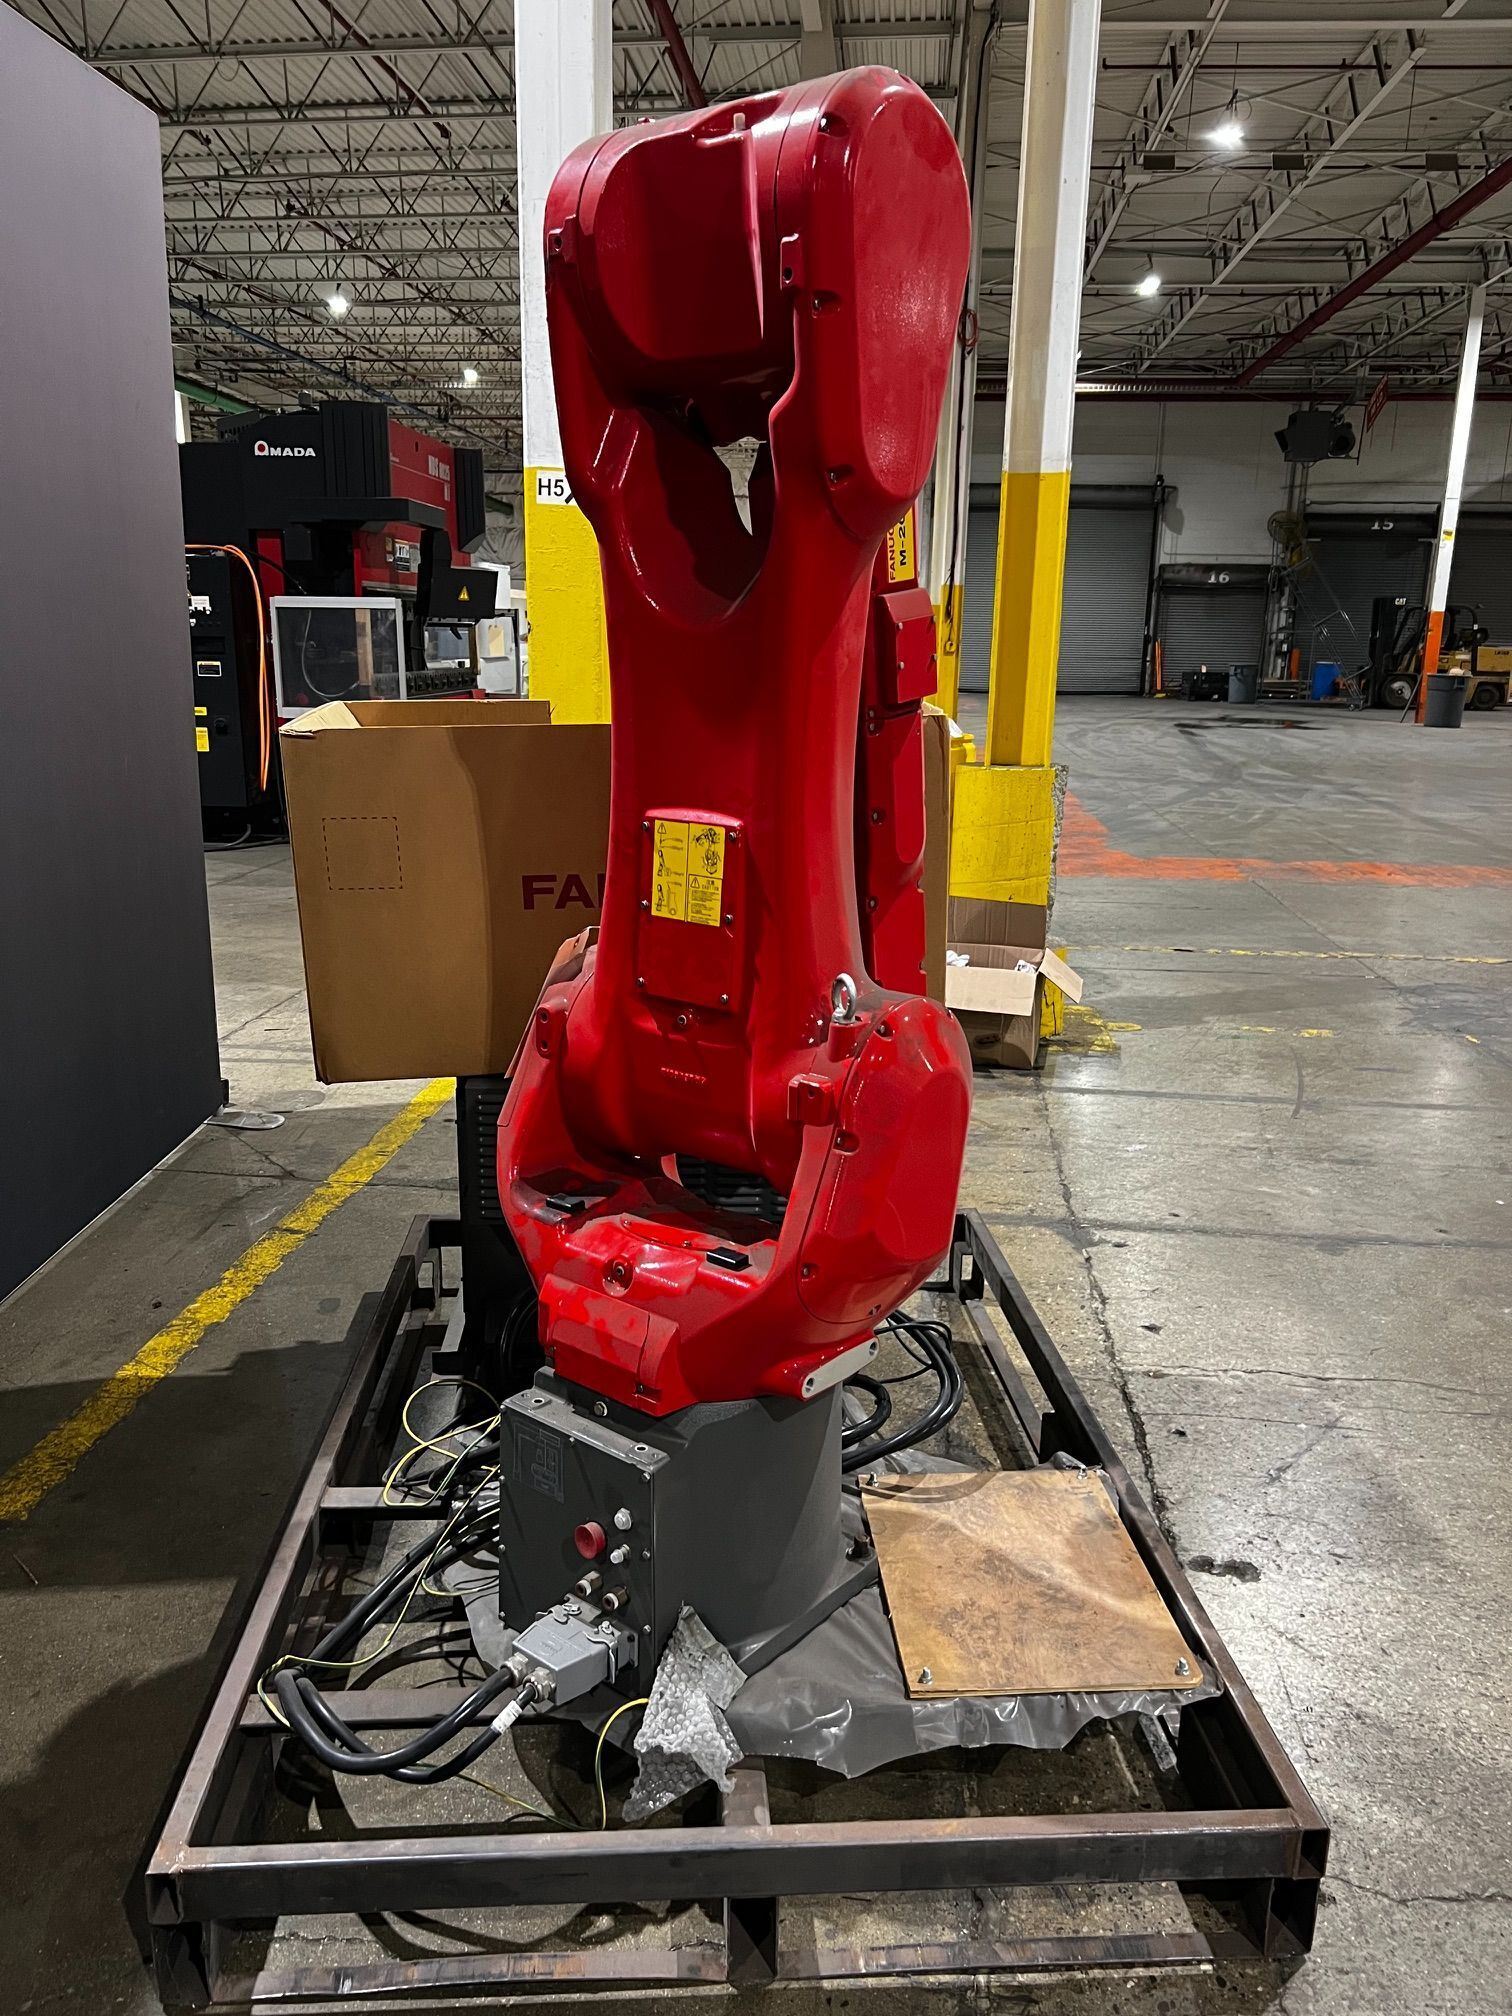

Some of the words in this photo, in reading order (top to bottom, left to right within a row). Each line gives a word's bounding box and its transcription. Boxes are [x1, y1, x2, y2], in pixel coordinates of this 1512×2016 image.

[254, 439, 317, 457] AMADA
[538, 477, 565, 497] H5
[1207, 570, 1230, 584] 16
[1394, 597, 1407, 606] CAT
